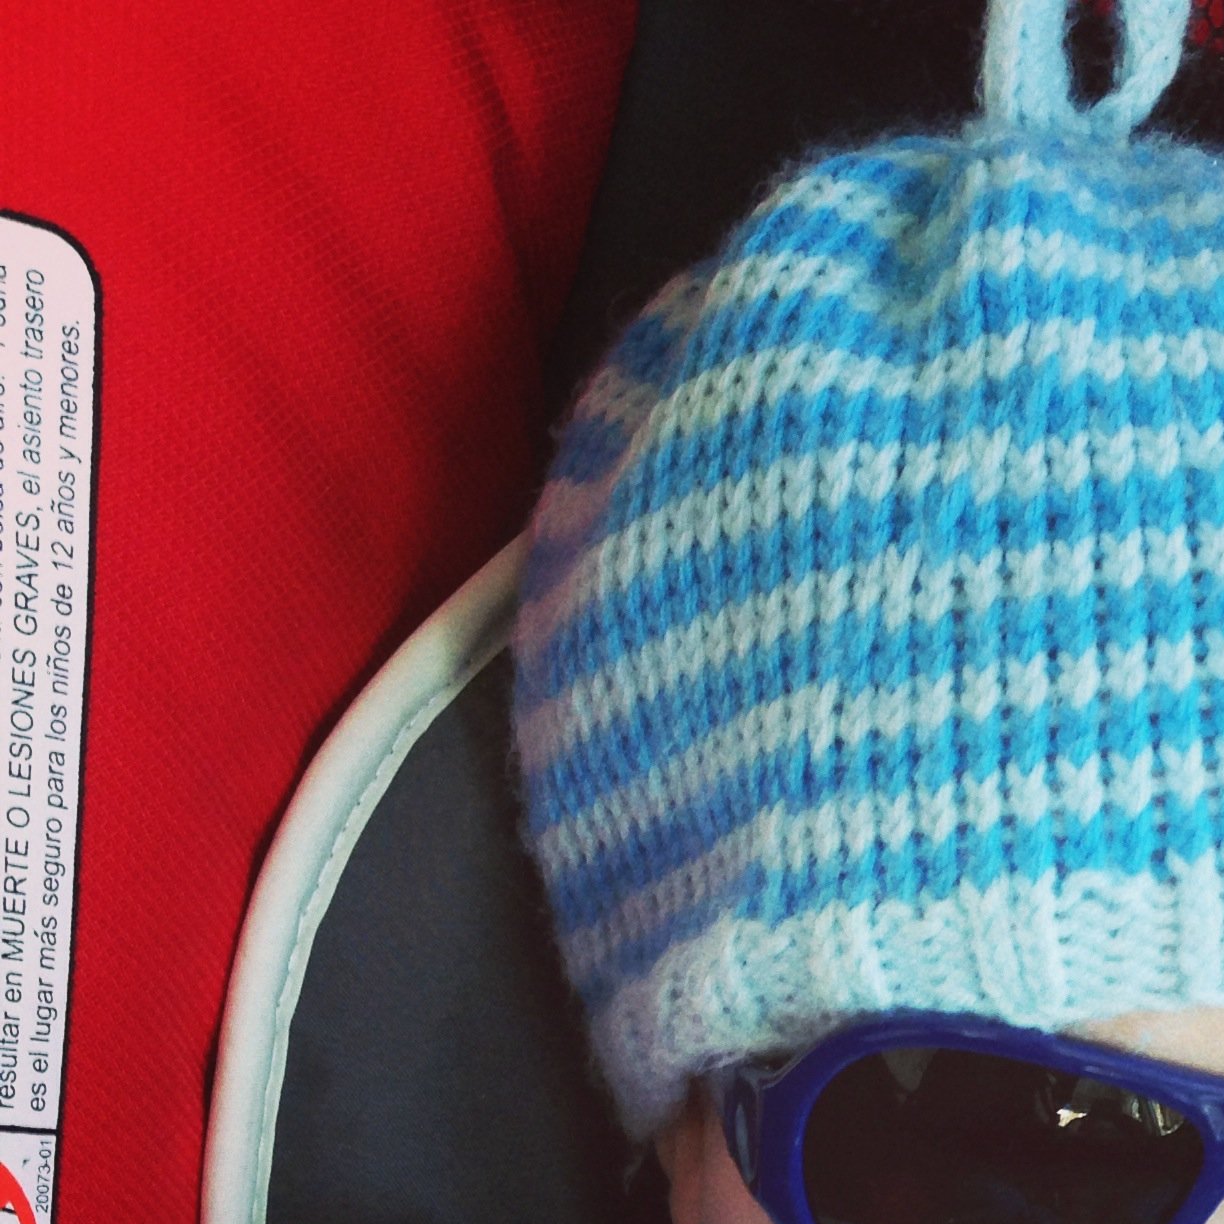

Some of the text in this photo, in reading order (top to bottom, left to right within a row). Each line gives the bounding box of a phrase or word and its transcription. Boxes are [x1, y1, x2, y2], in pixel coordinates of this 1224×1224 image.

[0, 269, 45, 1109] resultar en MUERTE O LESIONES GRAVES, el asiento trasero
[28, 320, 82, 1112] es el lugar más seguro para los niños de 12 años y menores.
[35, 1140, 52, 1213] 20073-01
